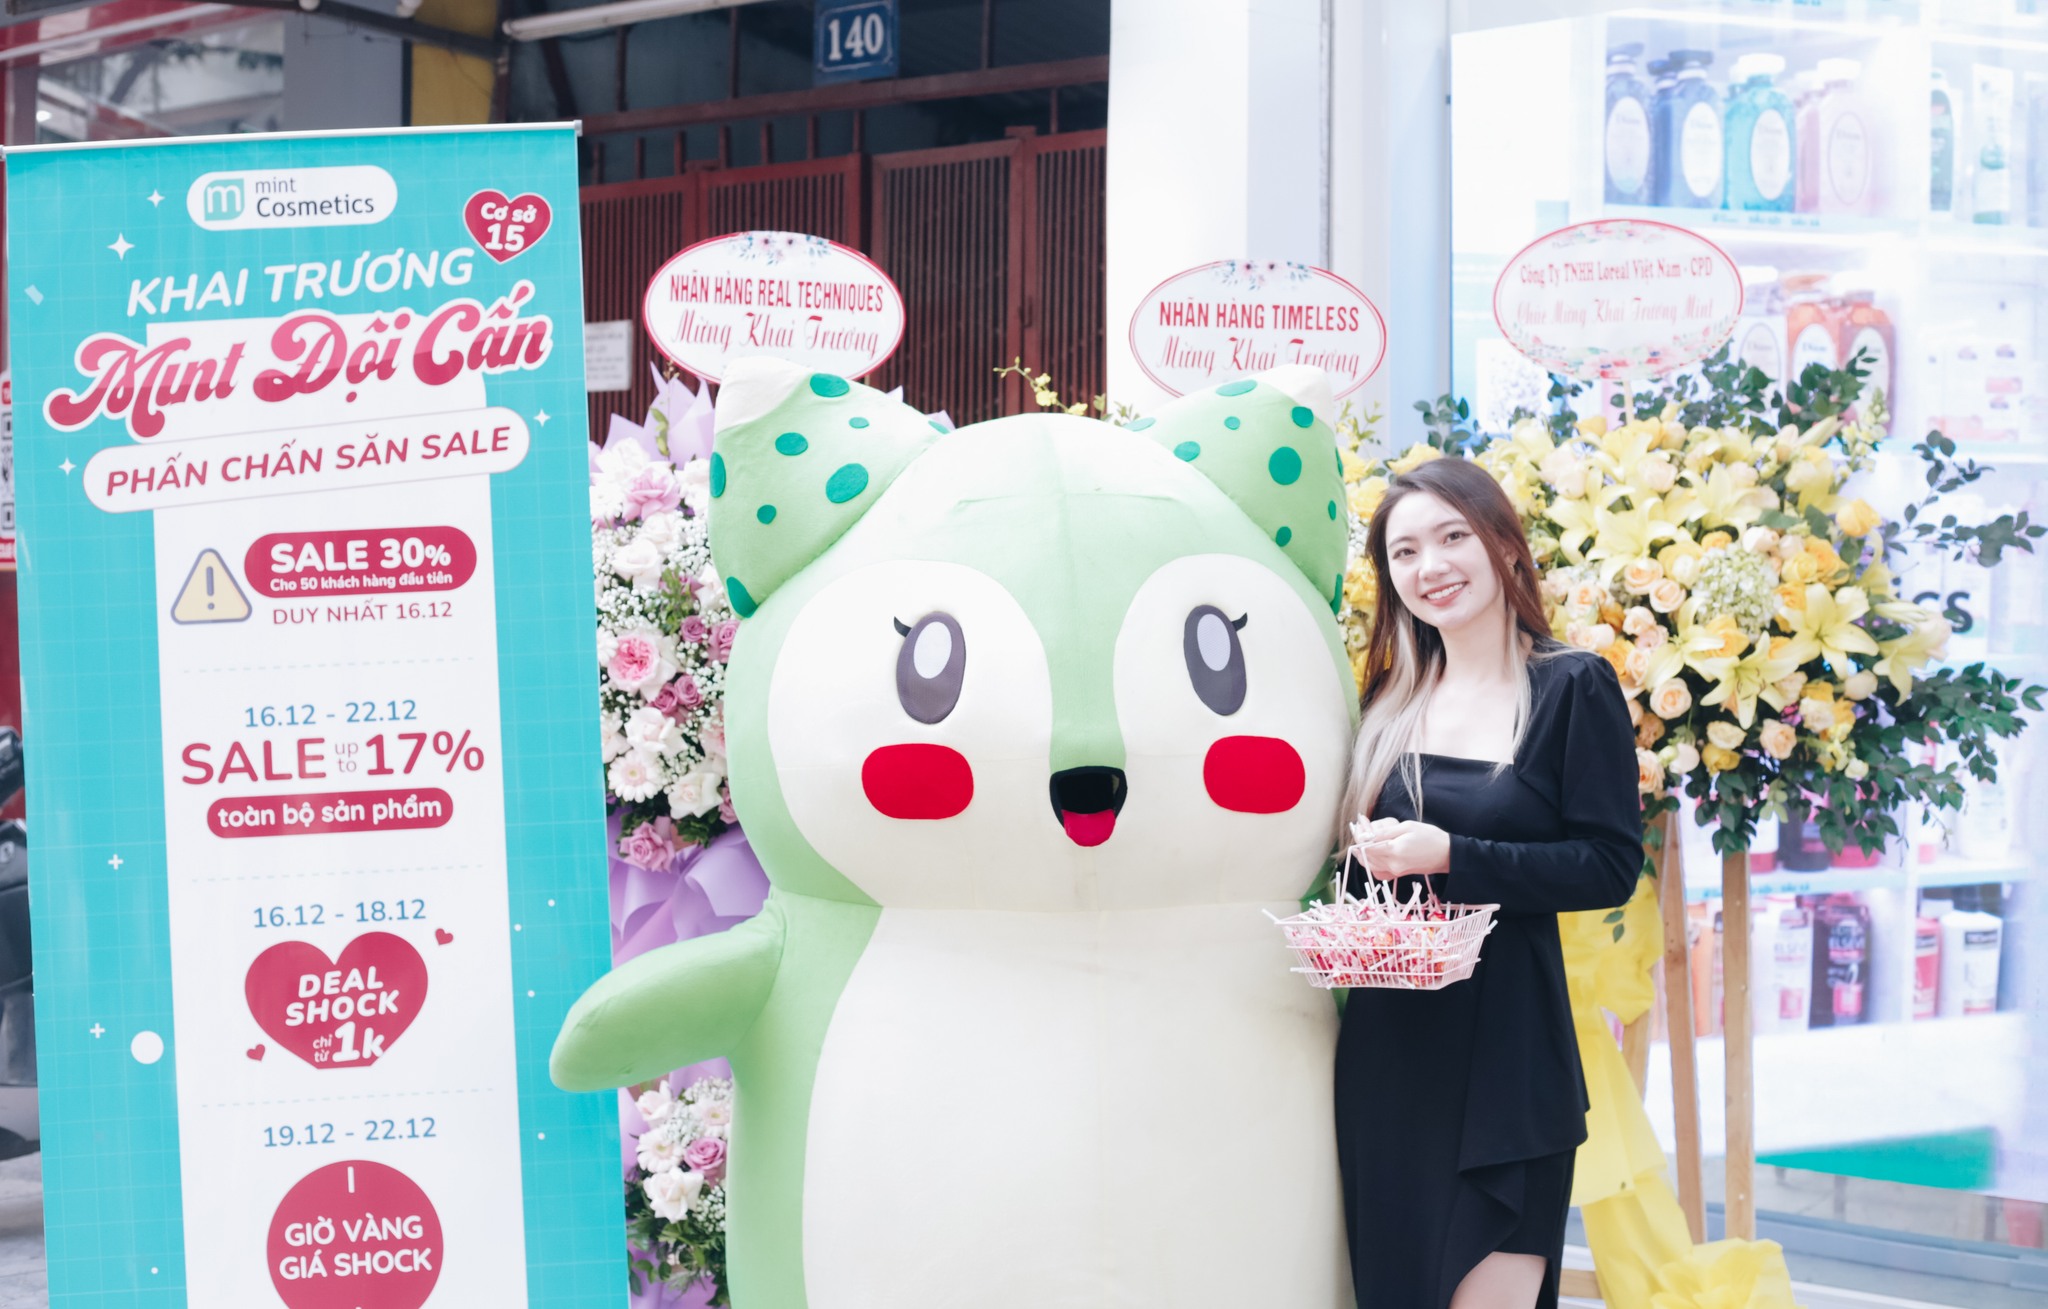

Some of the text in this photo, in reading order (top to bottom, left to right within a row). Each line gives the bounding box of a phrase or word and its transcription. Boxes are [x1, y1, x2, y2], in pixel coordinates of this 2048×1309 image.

[827, 13, 885, 60] 140
[255, 176, 297, 194] mint
[256, 194, 375, 218] Cosmetics
[480, 202, 537, 224] Cơ sở
[484, 223, 526, 252] 15
[126, 247, 476, 318] KHAI TRƯƠNG
[1548, 263, 1560, 286] Ty
[1564, 262, 1594, 283] TNHH
[1597, 261, 1630, 281] Loreal
[1633, 259, 1654, 285] Việt
[1656, 259, 1682, 279] Nam
[1690, 257, 1713, 277] CPD
[670, 270, 884, 314] NHÃN HÀNG REAL TECHNIQUES
[1159, 297, 1360, 332] NHÃN HÀNG TIMELESS
[671, 309, 880, 361] Mừng Khai Trương
[49, 285, 550, 438] Mint Đội Cấn
[1155, 335, 1216, 378] Mừng
[1223, 336, 1278, 371] Khai
[106, 425, 512, 496] PHẤN CHẤN SĂN SALE
[270, 537, 453, 575] SALE 30%
[270, 577, 297, 592] Cho
[300, 576, 319, 590] 50
[320, 575, 361, 590] khách
[362, 573, 396, 592] hàng
[427, 570, 453, 586] tiên
[272, 597, 454, 626] DUY NHẤT 16.12
[244, 704, 318, 728] 16.12
[345, 700, 418, 724] 22.12
[181, 729, 485, 786] SALE up to 17%
[218, 792, 442, 829] toàn bộ sản phẩm
[252, 904, 326, 928] 16.12
[355, 898, 427, 923] 18.12
[298, 966, 384, 999] DEAL
[285, 989, 399, 1027] SHOCK
[312, 1021, 386, 1062] chỉ 1k
[263, 1123, 336, 1148] 19.12
[364, 1116, 437, 1141] 22.12
[284, 1210, 424, 1247] GIỜ VÀNG
[279, 1246, 432, 1279] GIÁ SHOCK
